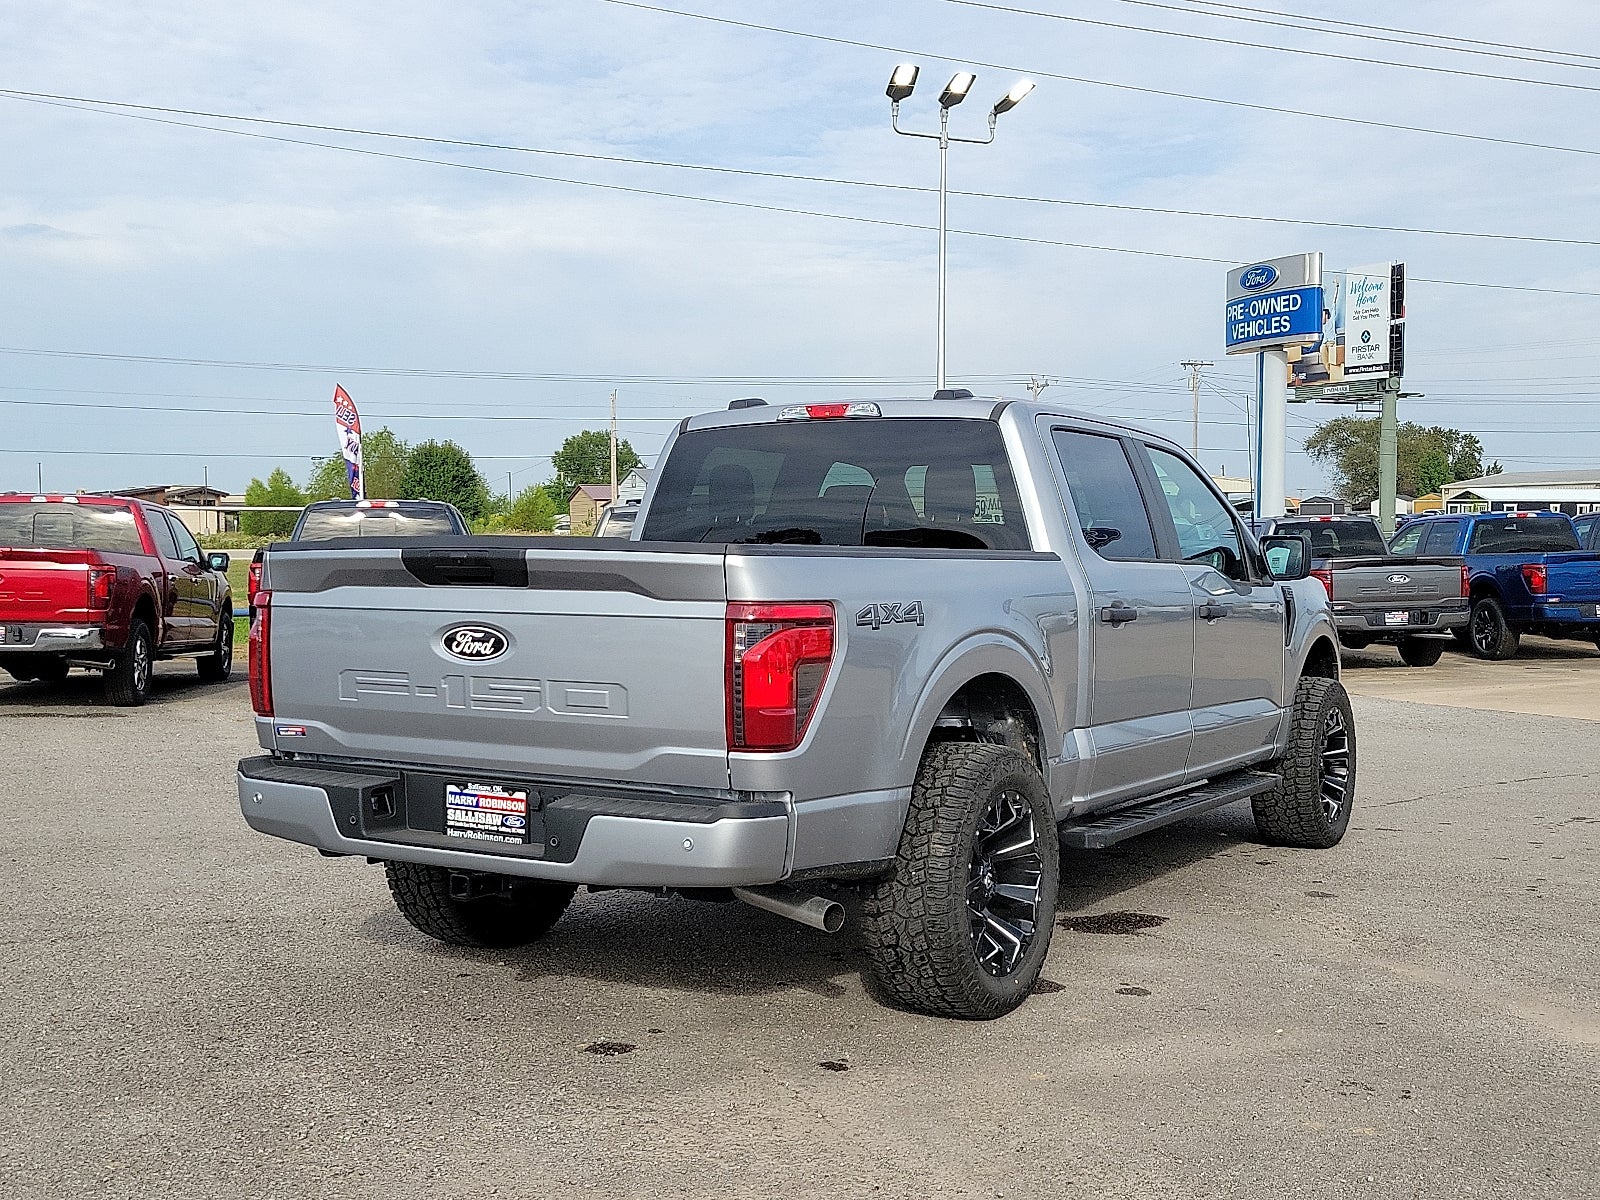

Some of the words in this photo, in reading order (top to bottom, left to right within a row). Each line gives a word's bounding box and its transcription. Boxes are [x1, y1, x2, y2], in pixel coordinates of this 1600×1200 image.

[1245, 268, 1268, 287] Ford
[1350, 276, 1384, 295] Welcome
[1226, 293, 1302, 323] PRE-OWNED
[1355, 293, 1378, 308] Home
[1232, 315, 1292, 341] VEHICLES
[1351, 343, 1381, 354] FIRSTAR
[450, 629, 496, 655] Ford
[338, 668, 629, 719] F-150
[493, 785, 503, 793] OK
[448, 794, 479, 806] HARRY
[479, 797, 525, 812] ROBINSON
[447, 808, 503, 825] SALLISAW
[447, 828, 522, 844] HarryRobinson.com
